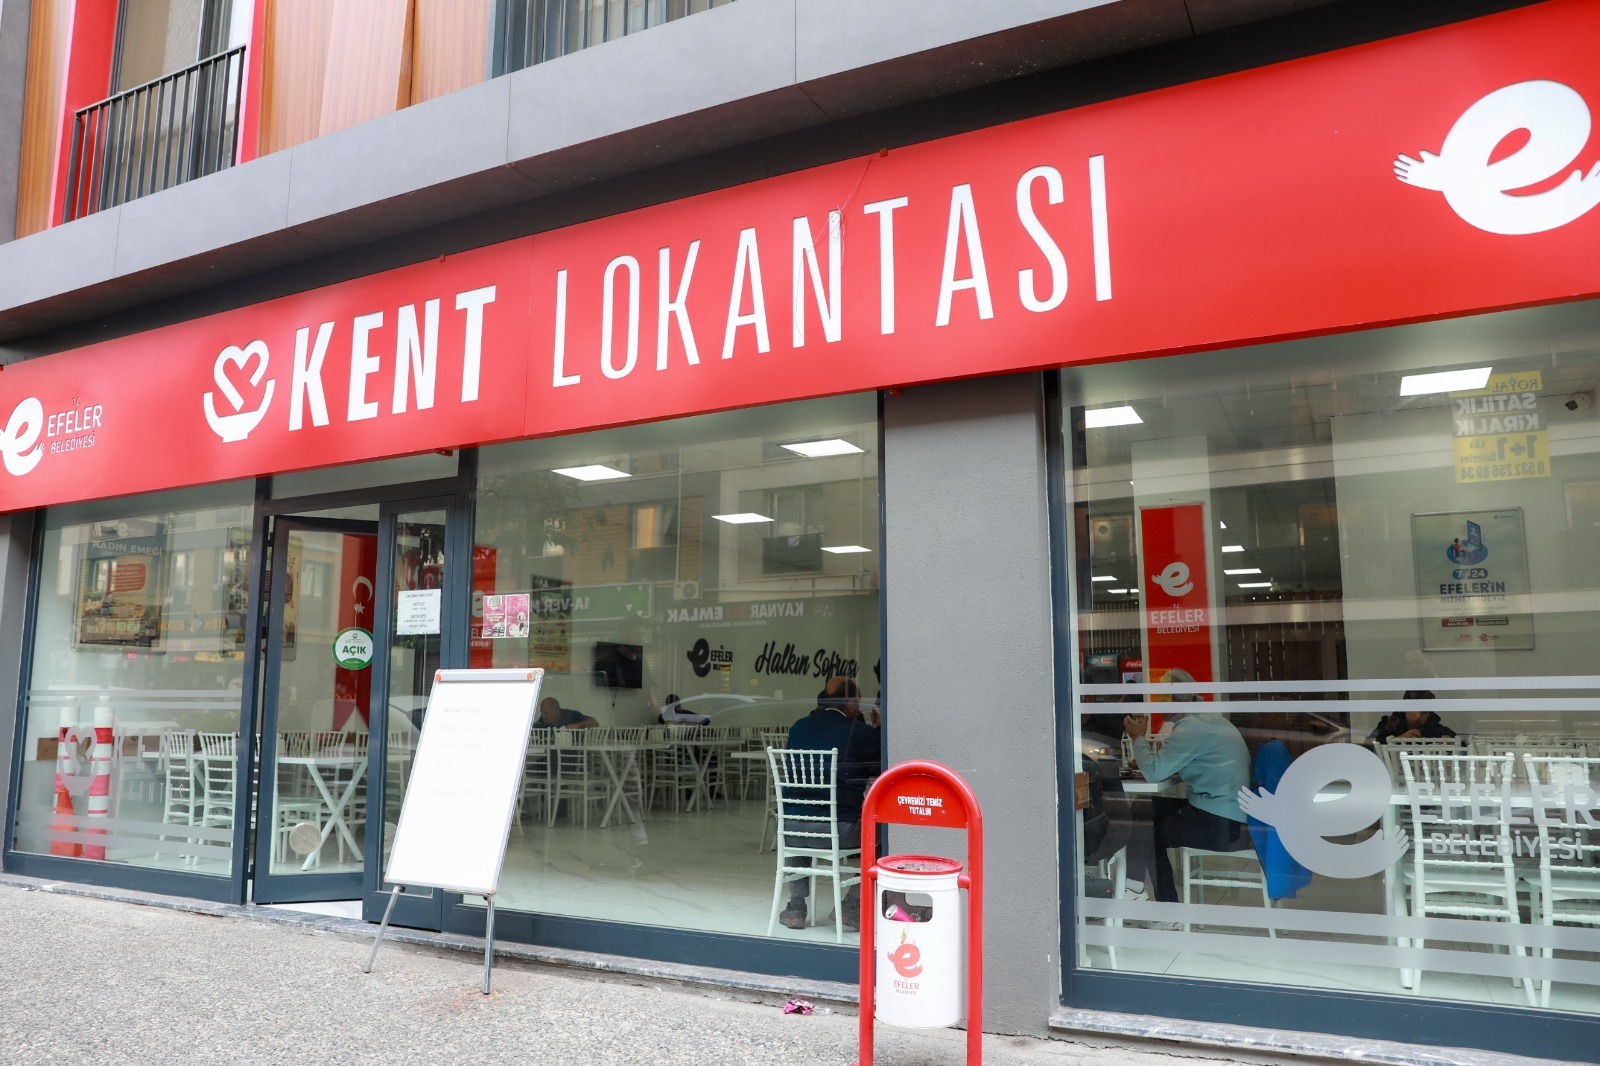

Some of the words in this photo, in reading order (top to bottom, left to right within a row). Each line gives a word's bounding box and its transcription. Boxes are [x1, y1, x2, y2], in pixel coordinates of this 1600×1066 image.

[288, 285, 498, 431] KENT
[551, 154, 1113, 387] LOKANTASI
[46, 404, 103, 438] EFELER
[50, 430, 96, 455] BELEDİYESİ
[92, 540, 127, 552] KADIN
[1150, 609, 1205, 624] EFELER
[1157, 623, 1200, 634] BELEDİYESİ
[341, 645, 367, 657] AÇIK
[710, 650, 734, 662] EFELER
[754, 640, 811, 676] Halkın
[112, 727, 195, 772] KENT
[897, 795, 925, 807] ÇEVREMİZİ
[926, 796, 943, 808] TEMİZ
[1410, 782, 1600, 828] EFELER
[908, 806, 932, 816] TUTALIN
[1431, 829, 1584, 860] BELEDİYESİ
[893, 979, 920, 990] EFELER
